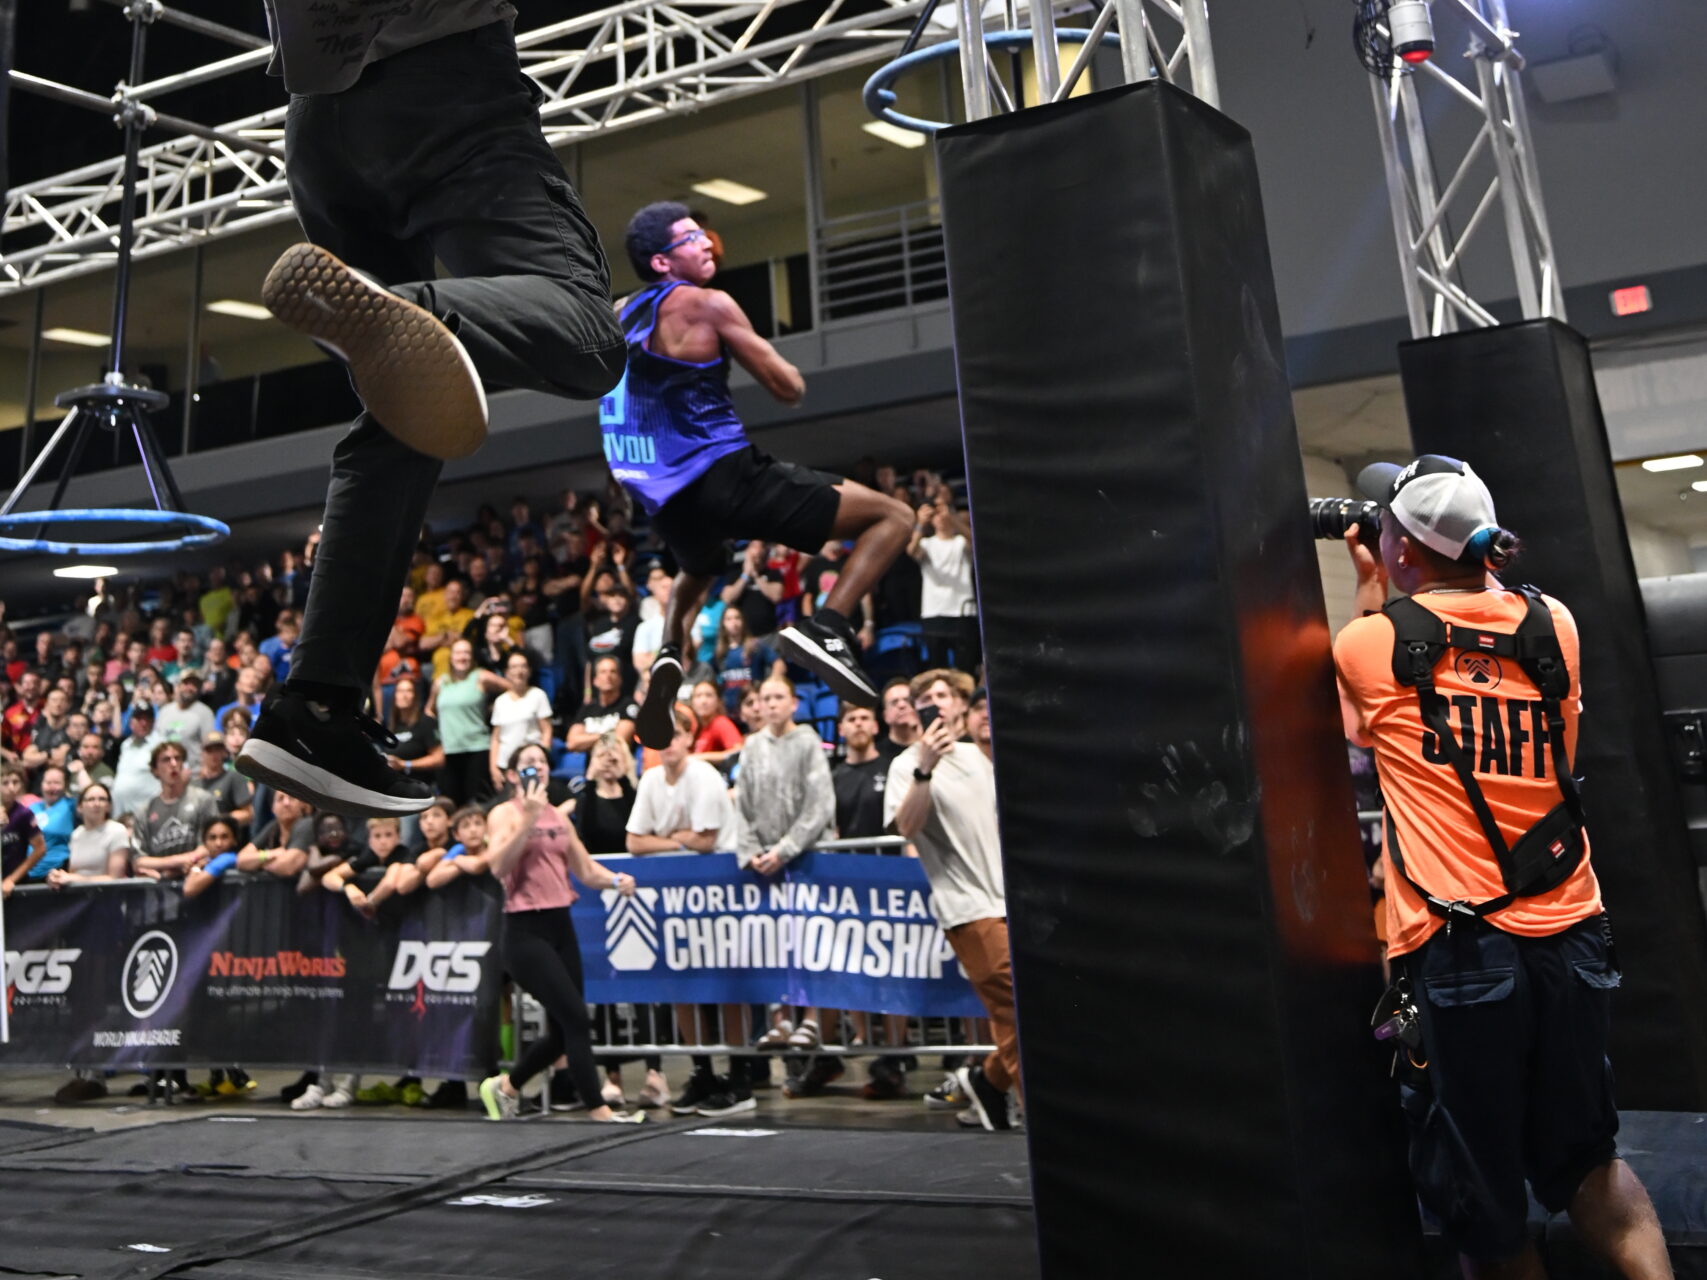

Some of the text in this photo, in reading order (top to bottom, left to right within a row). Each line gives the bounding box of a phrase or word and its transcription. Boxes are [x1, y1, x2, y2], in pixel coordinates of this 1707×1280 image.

[662, 883, 762, 915] WORLD
[769, 883, 860, 915] NINJA
[387, 940, 493, 993] DGS
[663, 914, 970, 980] CHAMPIONSHIP
